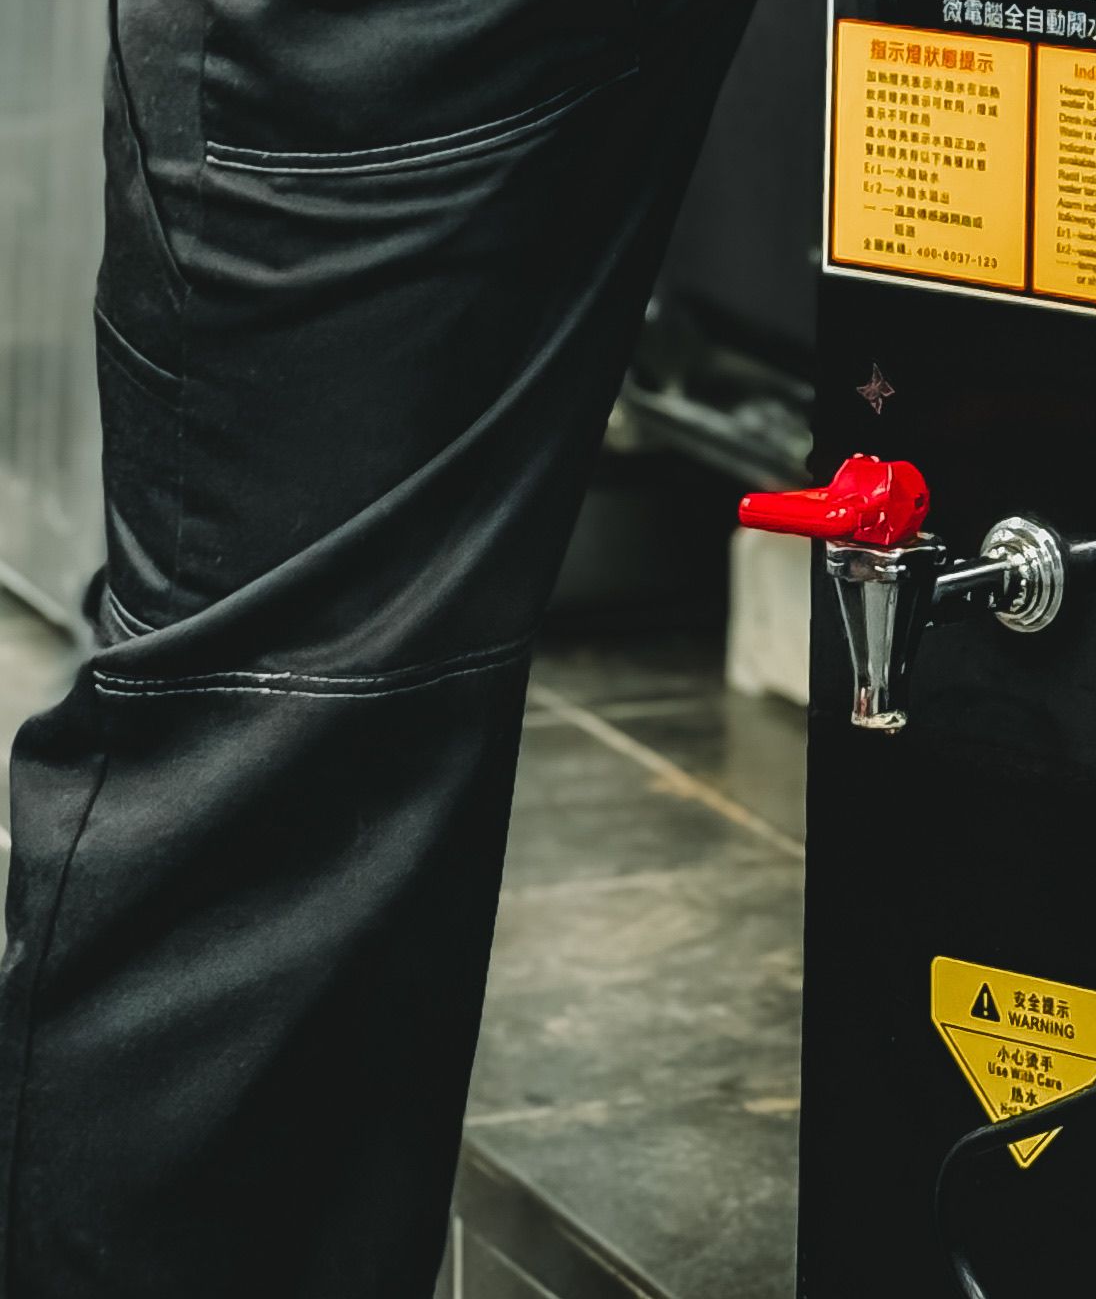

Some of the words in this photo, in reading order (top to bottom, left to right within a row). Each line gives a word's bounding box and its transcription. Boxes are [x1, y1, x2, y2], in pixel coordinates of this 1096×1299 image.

[1014, 990, 1070, 1019] 安全提示
[1008, 1010, 1075, 1040] WARNING
